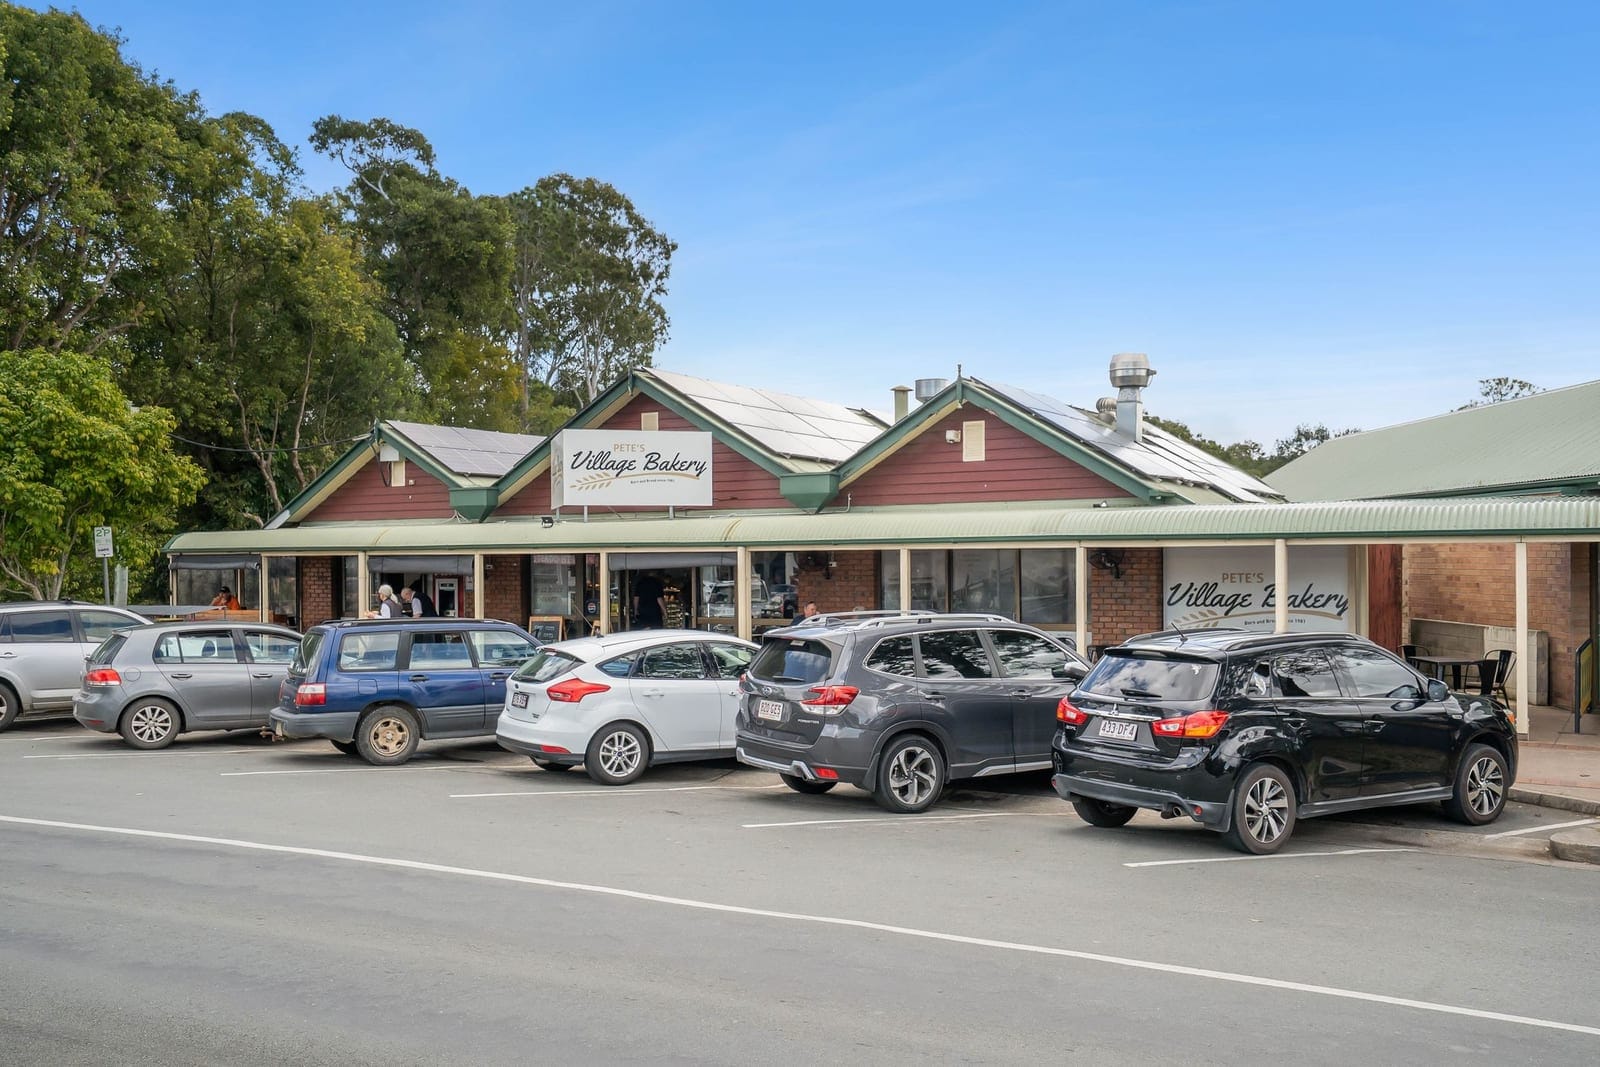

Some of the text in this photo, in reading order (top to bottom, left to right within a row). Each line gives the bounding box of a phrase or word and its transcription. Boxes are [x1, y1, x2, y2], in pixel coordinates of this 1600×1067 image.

[613, 443, 646, 453] PETE'S
[570, 450, 637, 478] Village
[643, 452, 708, 477] Bakery
[96, 529, 110, 537] 2P
[1221, 572, 1264, 584] PETE'S
[1166, 582, 1349, 616] Village Bakery
